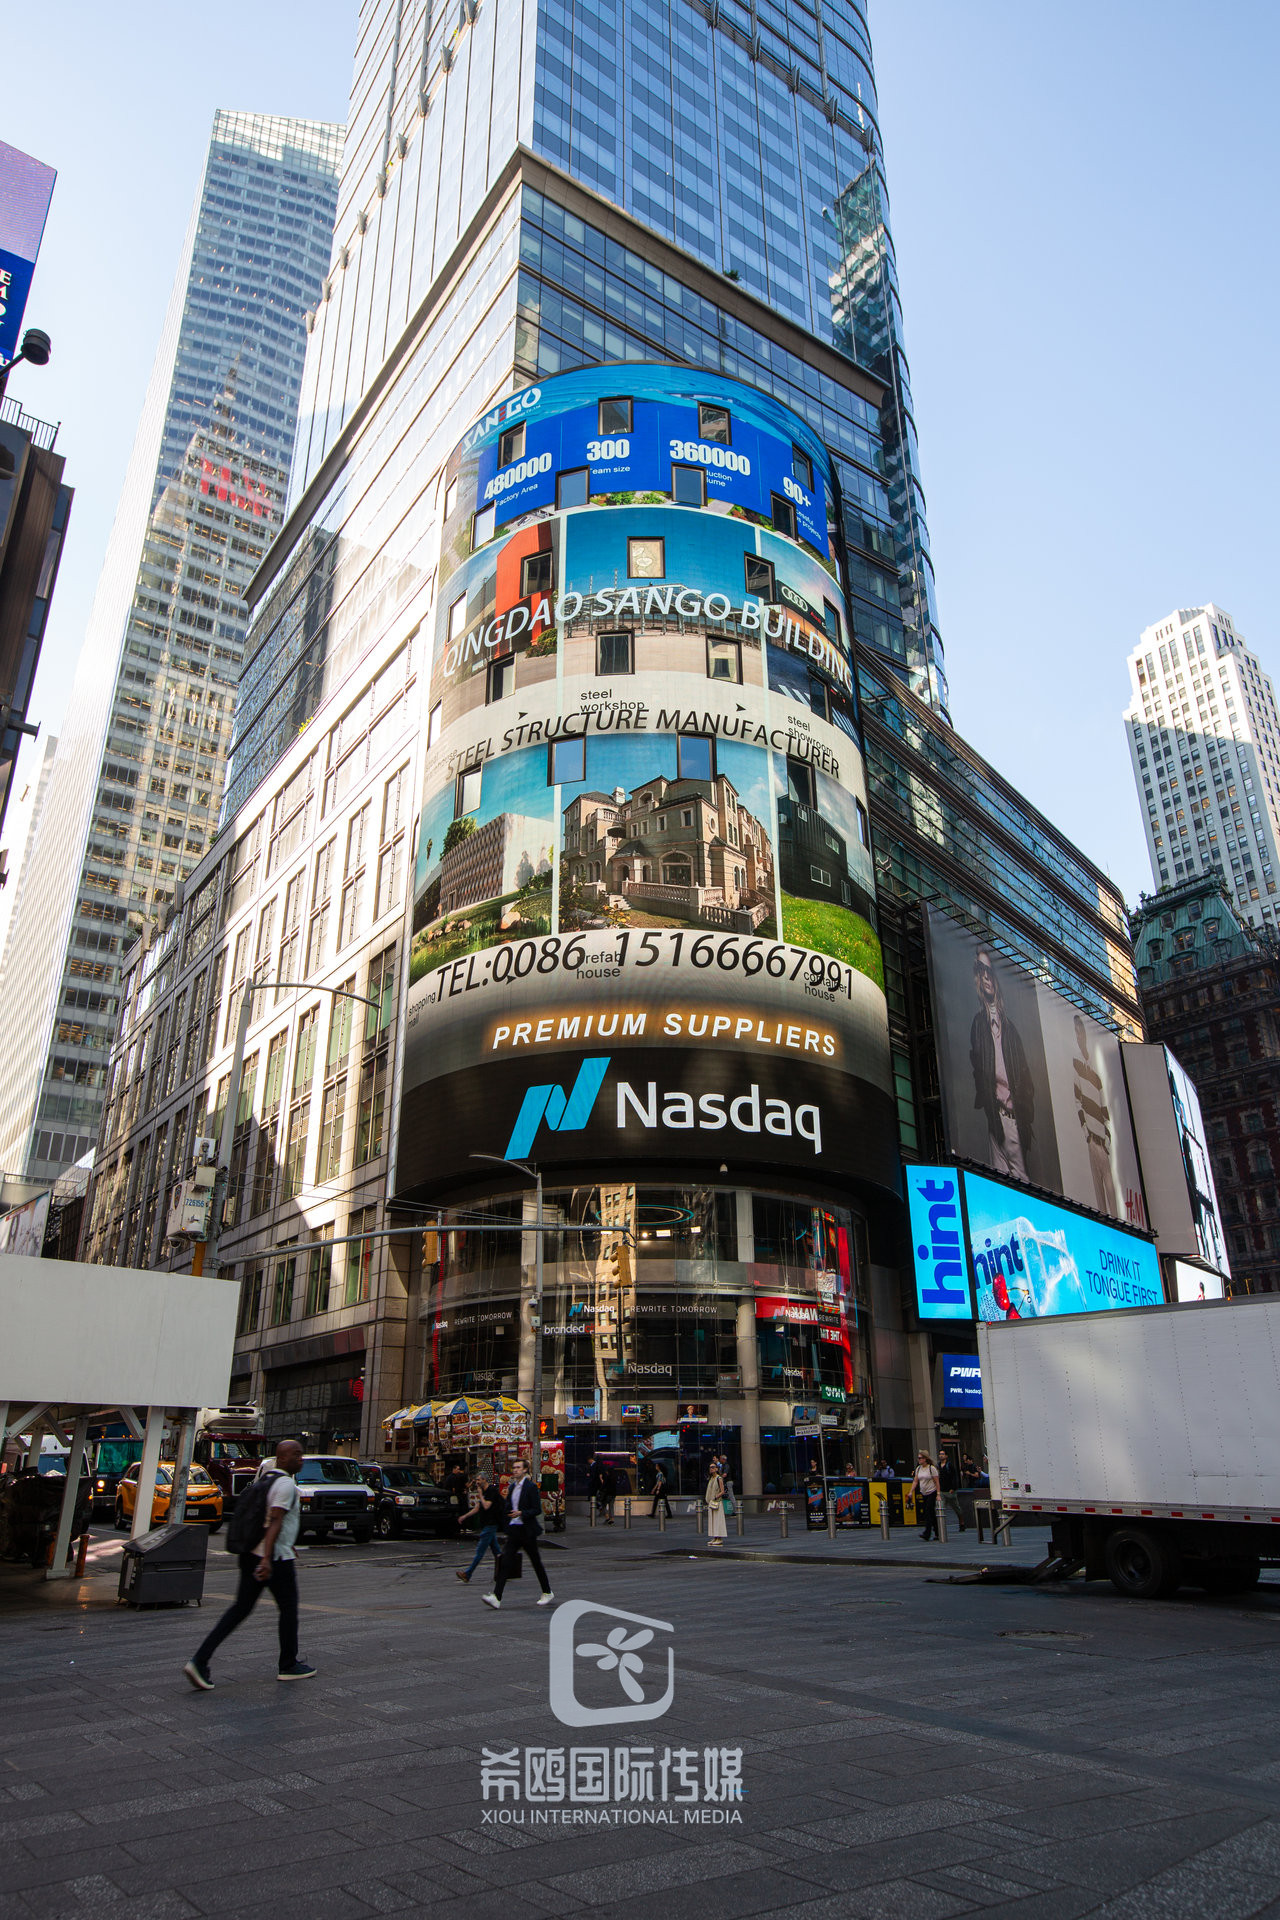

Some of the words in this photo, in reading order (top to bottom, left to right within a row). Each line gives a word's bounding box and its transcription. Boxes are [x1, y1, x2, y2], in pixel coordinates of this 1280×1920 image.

[586, 438, 630, 461] 300
[669, 439, 750, 476] 360000
[484, 452, 552, 500] 480000
[590, 467, 611, 475] eam
[613, 464, 630, 473] size
[521, 483, 538, 496] Area
[783, 476, 811, 507] 90+
[443, 590, 582, 678] QINGDAO
[594, 586, 731, 622] SANGO
[740, 600, 853, 694] BUILDING
[580, 689, 612, 700] steel
[580, 701, 645, 713] workshop
[787, 715, 810, 732] steel
[446, 737, 495, 779] STEEL
[501, 709, 649, 751] STRUCTURE
[656, 709, 839, 779] MANUFACTURER
[788, 727, 833, 757] showroom
[576, 966, 621, 979] house
[616, 931, 852, 1000] 15166667991
[408, 991, 436, 1017] shopping
[804, 984, 835, 1002] house
[492, 1013, 647, 1049] PREMIUM
[663, 1013, 836, 1056] SUPPLIERS
[616, 1081, 822, 1155] Nasdaq
[917, 1179, 965, 1304] hint
[971, 1231, 1024, 1290] hint
[1099, 1249, 1132, 1280] DRINK
[1132, 1260, 1141, 1281] IT
[1086, 1270, 1132, 1304] TONGUE
[1132, 1284, 1157, 1307] FIRST
[454, 1315, 475, 1325] REWRITE
[477, 1311, 512, 1322] TOMORROW
[584, 1304, 614, 1314] Nasdaq
[631, 1305, 667, 1313] REWRITE
[671, 1305, 718, 1313] TOMORROW
[628, 1362, 672, 1376] Nasdaq
